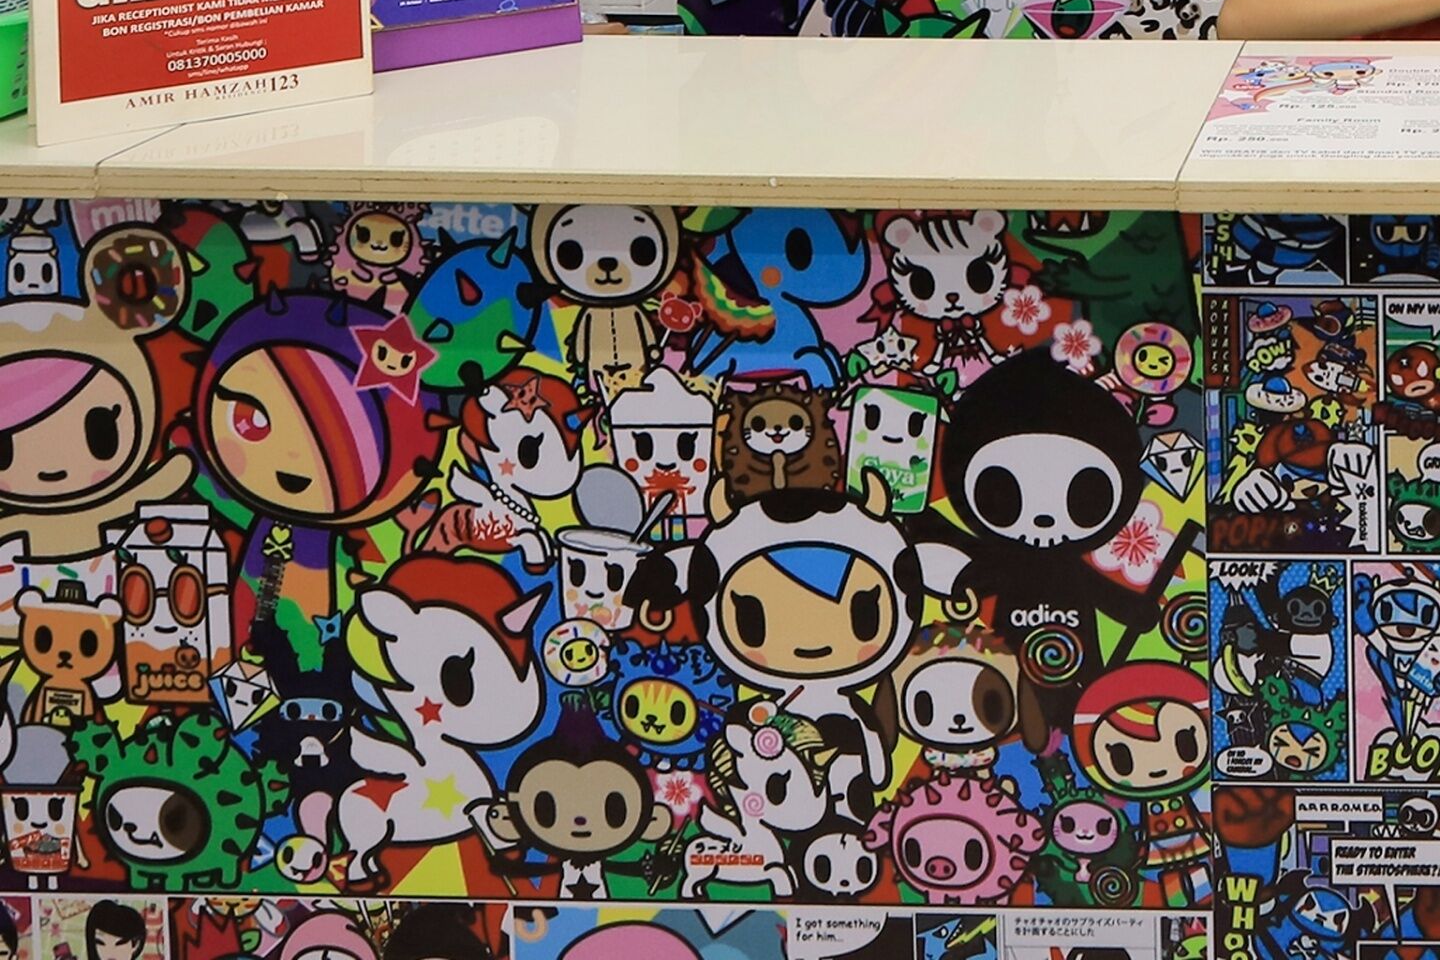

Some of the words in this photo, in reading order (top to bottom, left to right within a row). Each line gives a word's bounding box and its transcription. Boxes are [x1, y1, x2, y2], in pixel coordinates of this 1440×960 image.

[92, 13, 116, 25] JIKA
[118, 5, 194, 22] RECEPTIONIST
[196, 0, 226, 11] KAMI
[102, 25, 128, 37] BON
[130, 13, 222, 33] REGISTRASI/BON
[223, 5, 284, 21] PEMBELIAN
[285, 0, 325, 12] KAMAR
[191, 26, 205, 34] sms
[206, 23, 229, 32] nomor
[229, 19, 259, 29] dibawah
[166, 49, 188, 58] Untuk
[215, 42, 234, 51] Saran
[234, 38, 263, 49] Hubungi
[196, 37, 220, 46] Terima
[220, 34, 239, 43] Kasih
[167, 47, 267, 72] 081370005000
[126, 93, 175, 109] AMIR
[185, 78, 267, 100] HAMZAH
[271, 73, 299, 92] 123
[91, 198, 162, 232] milk
[425, 203, 504, 238] atte
[1406, 303, 1425, 315] MY
[1248, 339, 1292, 373] POW!
[1358, 502, 1368, 541] tokidoki
[1219, 562, 1266, 577] LOOK!
[1010, 603, 1080, 628] adios
[132, 665, 205, 698] juice
[1335, 846, 1366, 859] READY
[1368, 846, 1383, 859] TO
[1383, 846, 1417, 859] ENTER
[1335, 863, 1354, 877] THE
[796, 917, 803, 929] I
[805, 918, 824, 930] got
[826, 917, 881, 930] something
[796, 929, 813, 942] for
